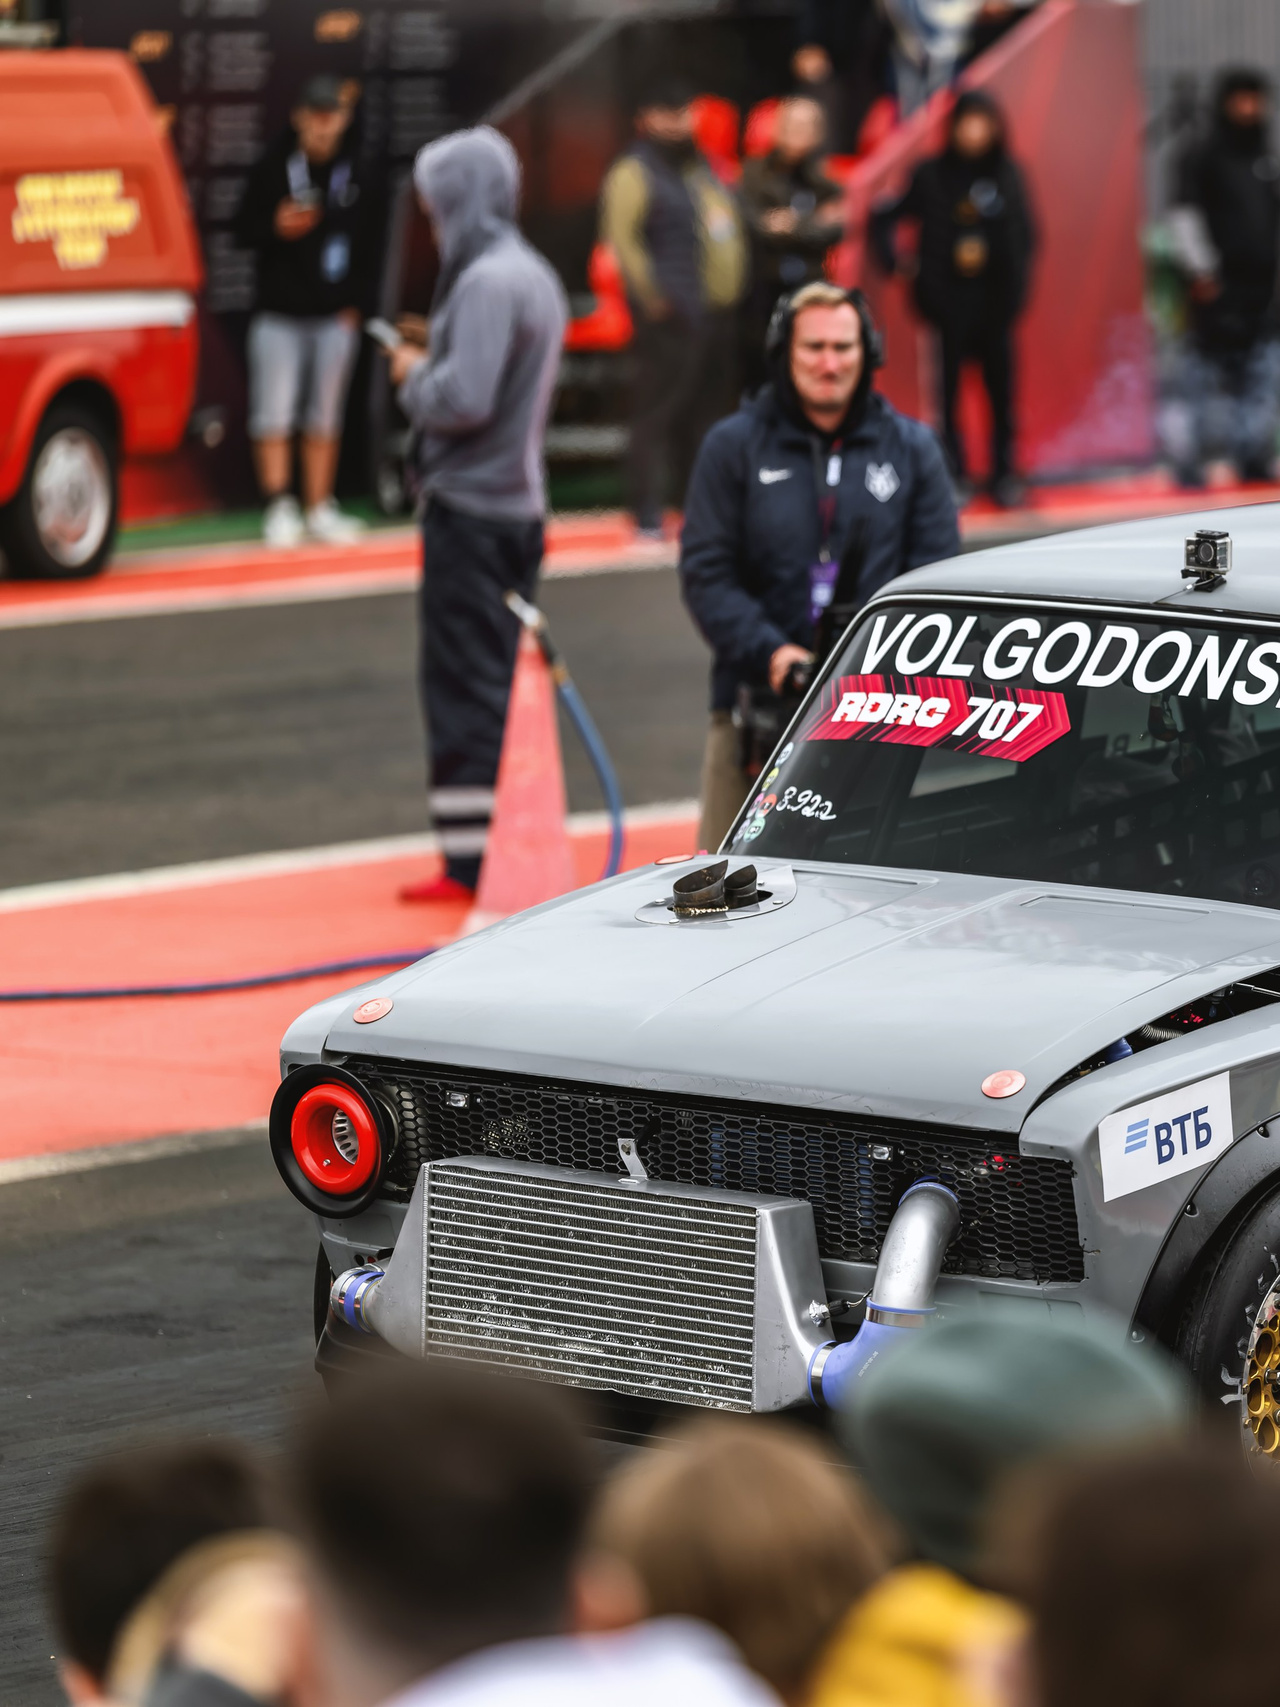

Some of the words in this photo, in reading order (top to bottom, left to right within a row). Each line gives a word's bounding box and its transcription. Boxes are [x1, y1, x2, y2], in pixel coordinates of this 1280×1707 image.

[831, 692, 951, 728] RDRC
[952, 696, 1044, 742] 707
[1154, 1105, 1212, 1165] ВТБ
